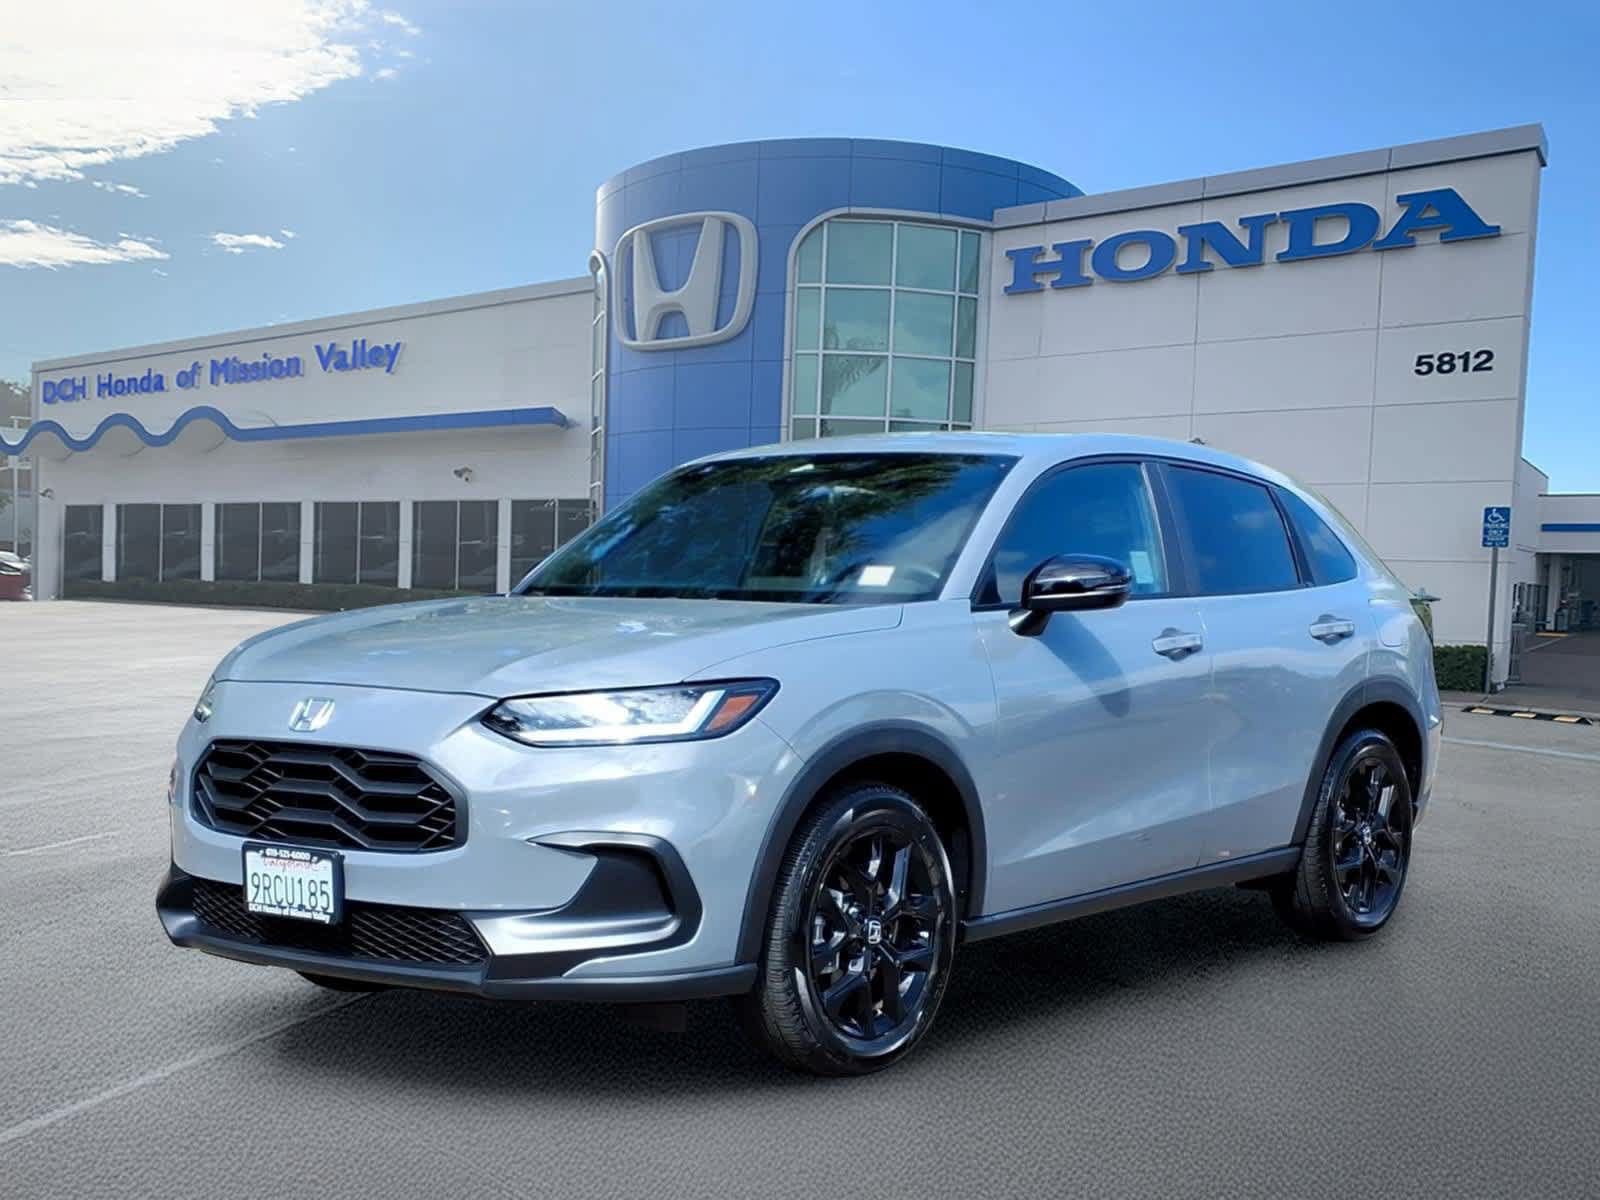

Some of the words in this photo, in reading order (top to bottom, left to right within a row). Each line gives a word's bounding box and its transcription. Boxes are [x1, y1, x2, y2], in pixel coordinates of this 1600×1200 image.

[1004, 188, 1501, 295] HONDA
[42, 374, 87, 404] DCH
[97, 368, 164, 397] Honda
[175, 361, 202, 388] of
[210, 352, 302, 385] Mission
[314, 339, 401, 373] Valley
[1414, 349, 1494, 376] 5812
[251, 872, 330, 912] 9RCU185
